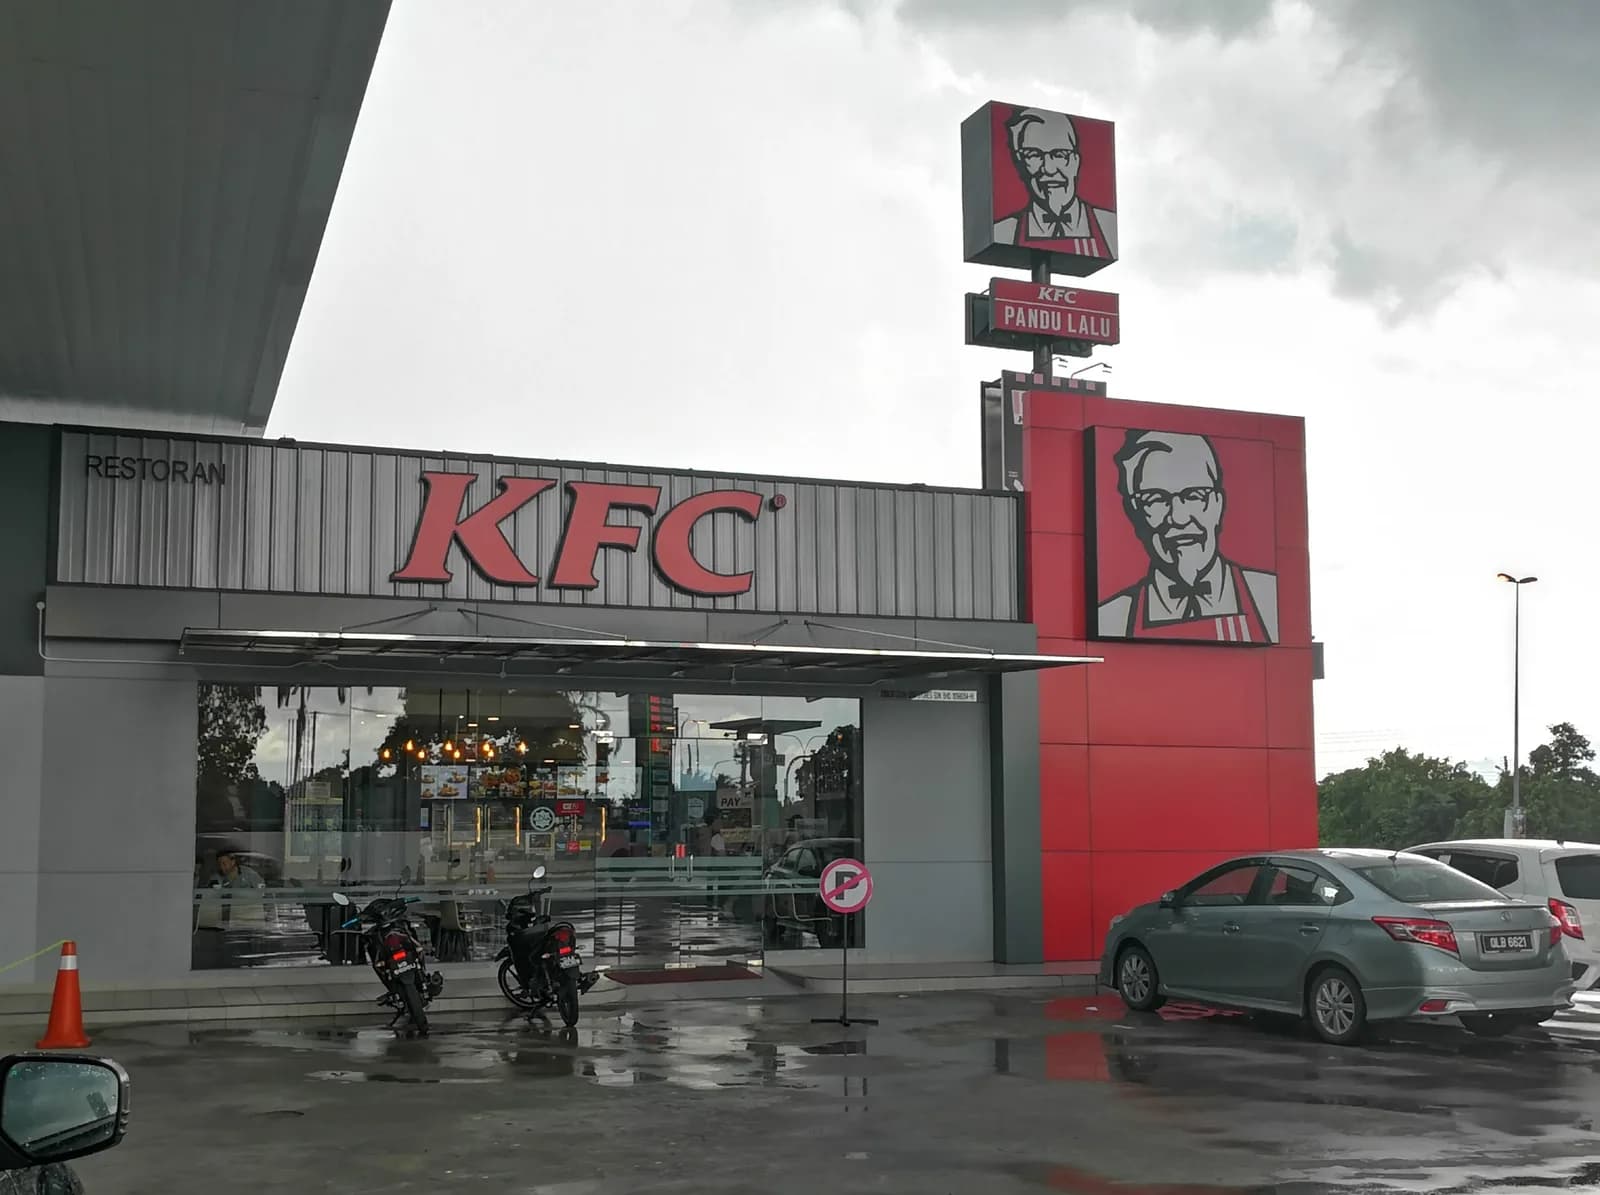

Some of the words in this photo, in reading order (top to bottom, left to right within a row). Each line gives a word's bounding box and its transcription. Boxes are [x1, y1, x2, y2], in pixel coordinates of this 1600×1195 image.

[1038, 287, 1077, 304] KFC
[1005, 305, 1061, 331] PANDU
[1068, 313, 1110, 337] LALU
[86, 455, 225, 485] RESTORAN
[390, 471, 764, 596] KFC
[721, 797, 741, 807] PAY
